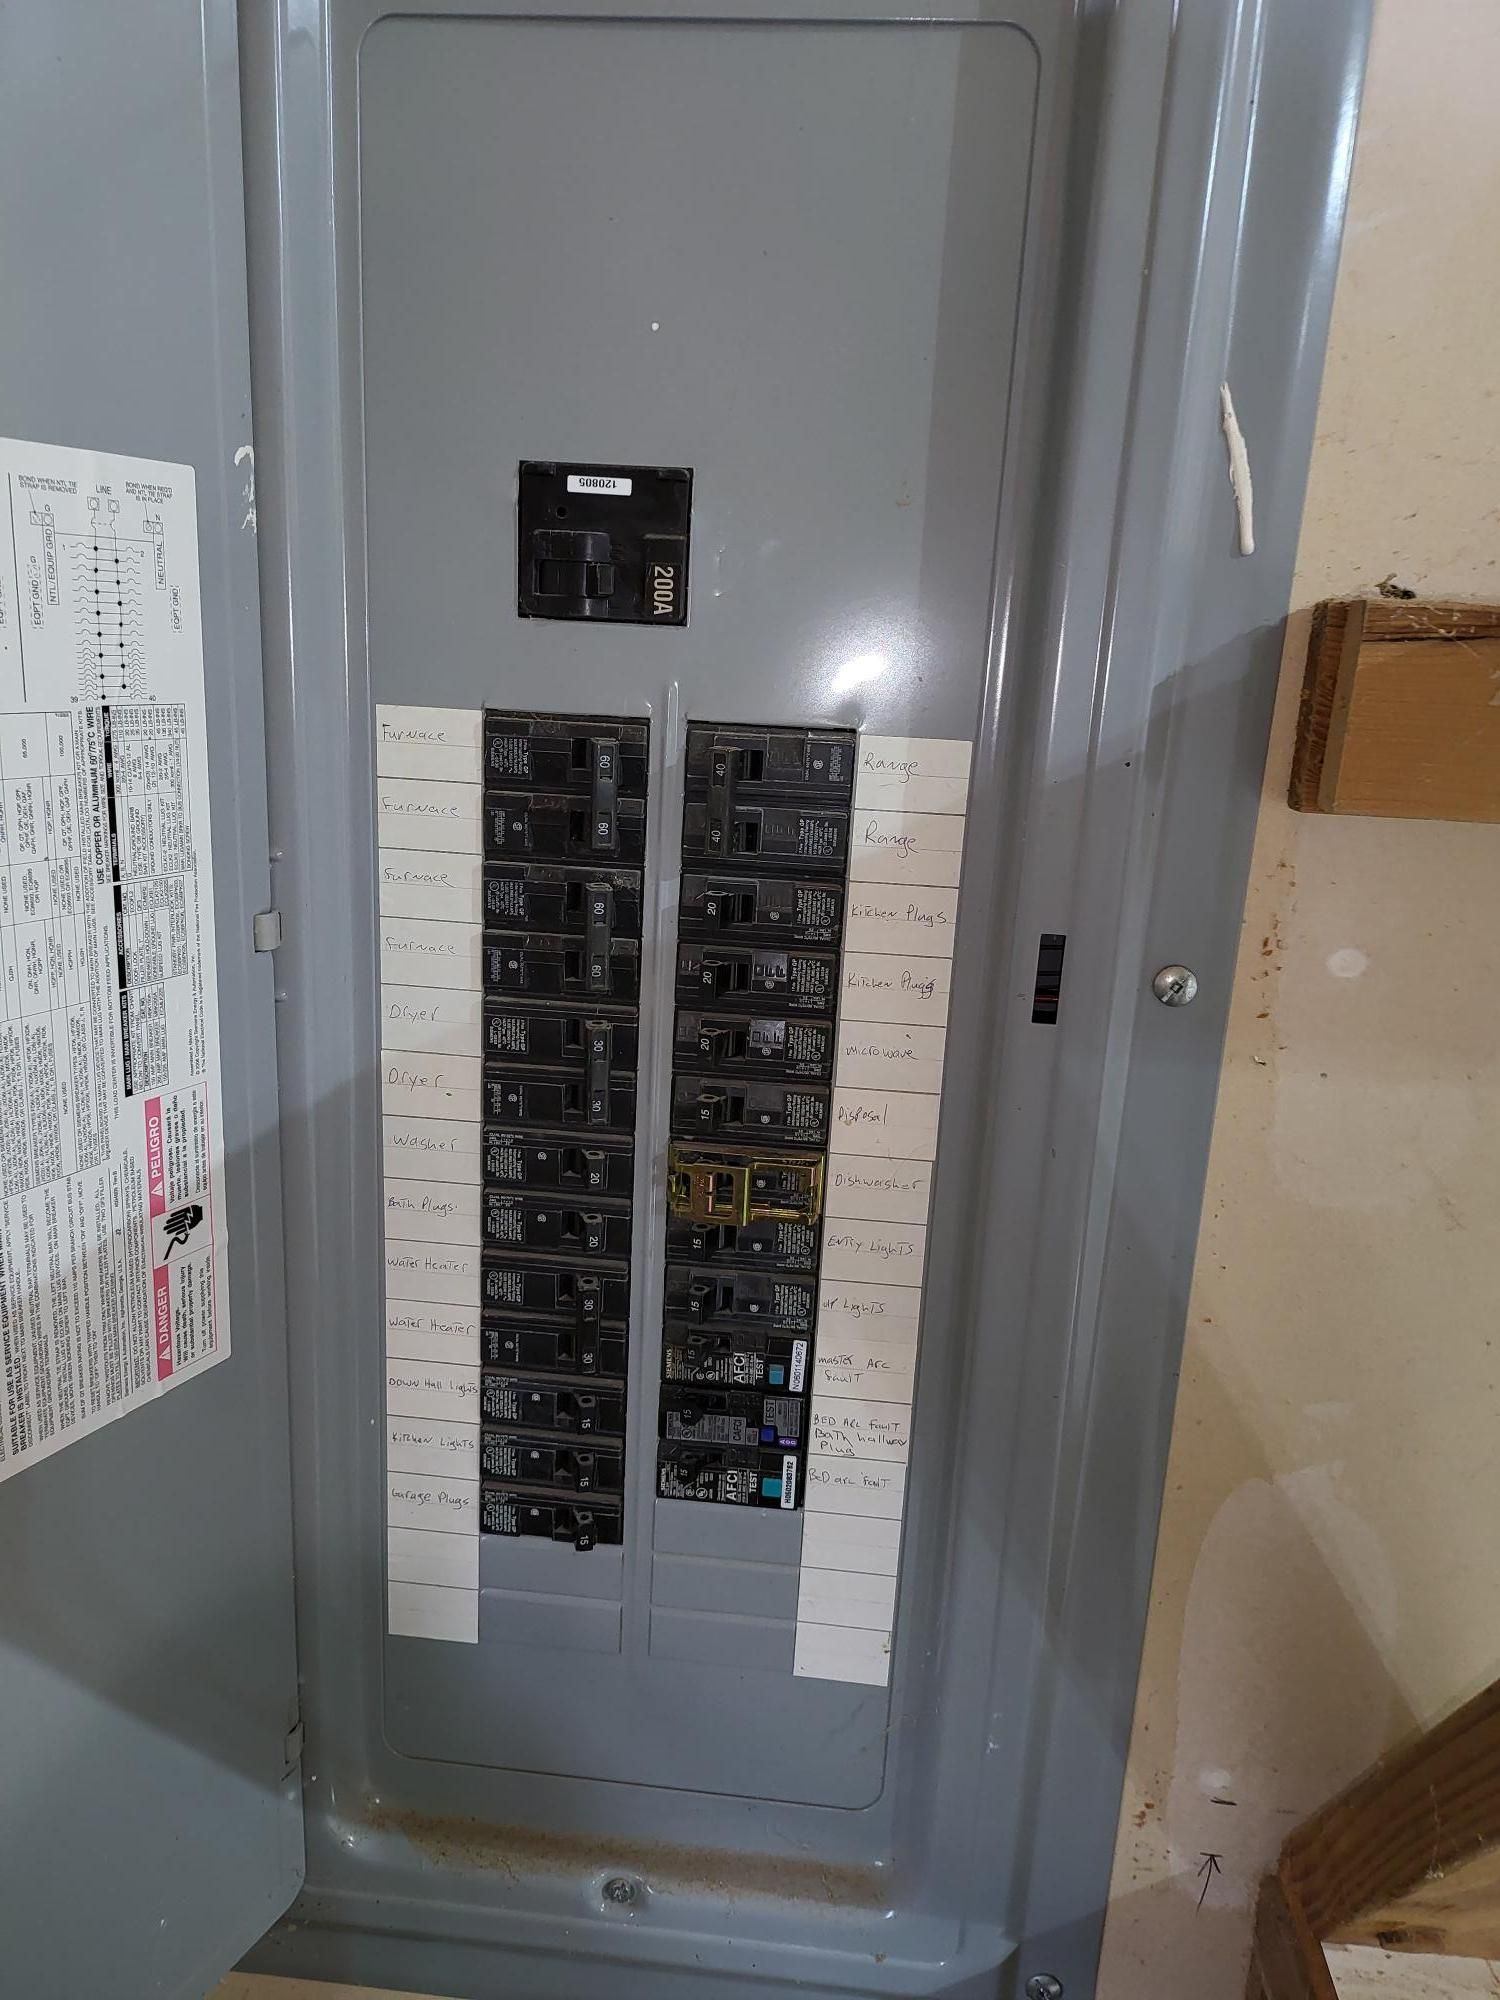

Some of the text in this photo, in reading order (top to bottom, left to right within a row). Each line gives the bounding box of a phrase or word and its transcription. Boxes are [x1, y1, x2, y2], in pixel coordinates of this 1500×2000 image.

[96, 485, 112, 495] LINE
[579, 478, 617, 488] 120805
[46, 528, 57, 602] NTL/EQUIP GRD
[654, 566, 674, 615] 200A
[86, 707, 94, 728] WIRE
[600, 755, 610, 768] 60
[864, 752, 919, 783] Range
[716, 763, 726, 777] 40
[91, 768, 99, 812] ALUMINUM
[94, 816, 101, 827] OR
[598, 822, 609, 835] 60
[711, 830, 721, 843] 40
[864, 820, 920, 858] Range
[94, 829, 104, 865] COPPER
[93, 868, 104, 884] USE
[594, 902, 604, 915] 60
[708, 902, 716, 916] 20
[591, 965, 601, 978] 60
[703, 972, 712, 984] 20
[389, 1004, 440, 1024] Dryer
[593, 1039, 603, 1051] 30
[701, 1039, 709, 1050] 20
[388, 1068, 443, 1091] Dryer
[592, 1101, 601, 1112] 30
[701, 1110, 709, 1120] 15
[149, 1116, 161, 1178] PELIGRO
[590, 1173, 599, 1183] 20
[589, 1236, 599, 1247] 20
[693, 1238, 702, 1249] 15
[0, 1281, 9, 1328] EQUIPMENT
[584, 1299, 593, 1310] 30
[691, 1301, 700, 1311] 15
[157, 1286, 169, 1344] DANGER
[2, 1329, 13, 1365] SERVICE
[583, 1353, 592, 1364] 30
[688, 1350, 695, 1359] 15
[6, 1367, 12, 1377] AS
[733, 1352, 745, 1383] AFCI
[756, 1359, 764, 1379] TEST
[14, 1357, 24, 1401] INSTALLED
[6, 1379, 14, 1396] USE
[683, 1410, 691, 1418] 15
[766, 1401, 774, 1423] TEST
[582, 1418, 591, 1428] 15
[732, 1419, 743, 1441] CAFCI
[9, 1416, 20, 1455] SUITABLE
[18, 1412, 27, 1451] BREAKER
[580, 1476, 589, 1487] 15
[726, 1470, 738, 1500] AFCI
[749, 1472, 757, 1492] TEST
[580, 1535, 589, 1545] 15
